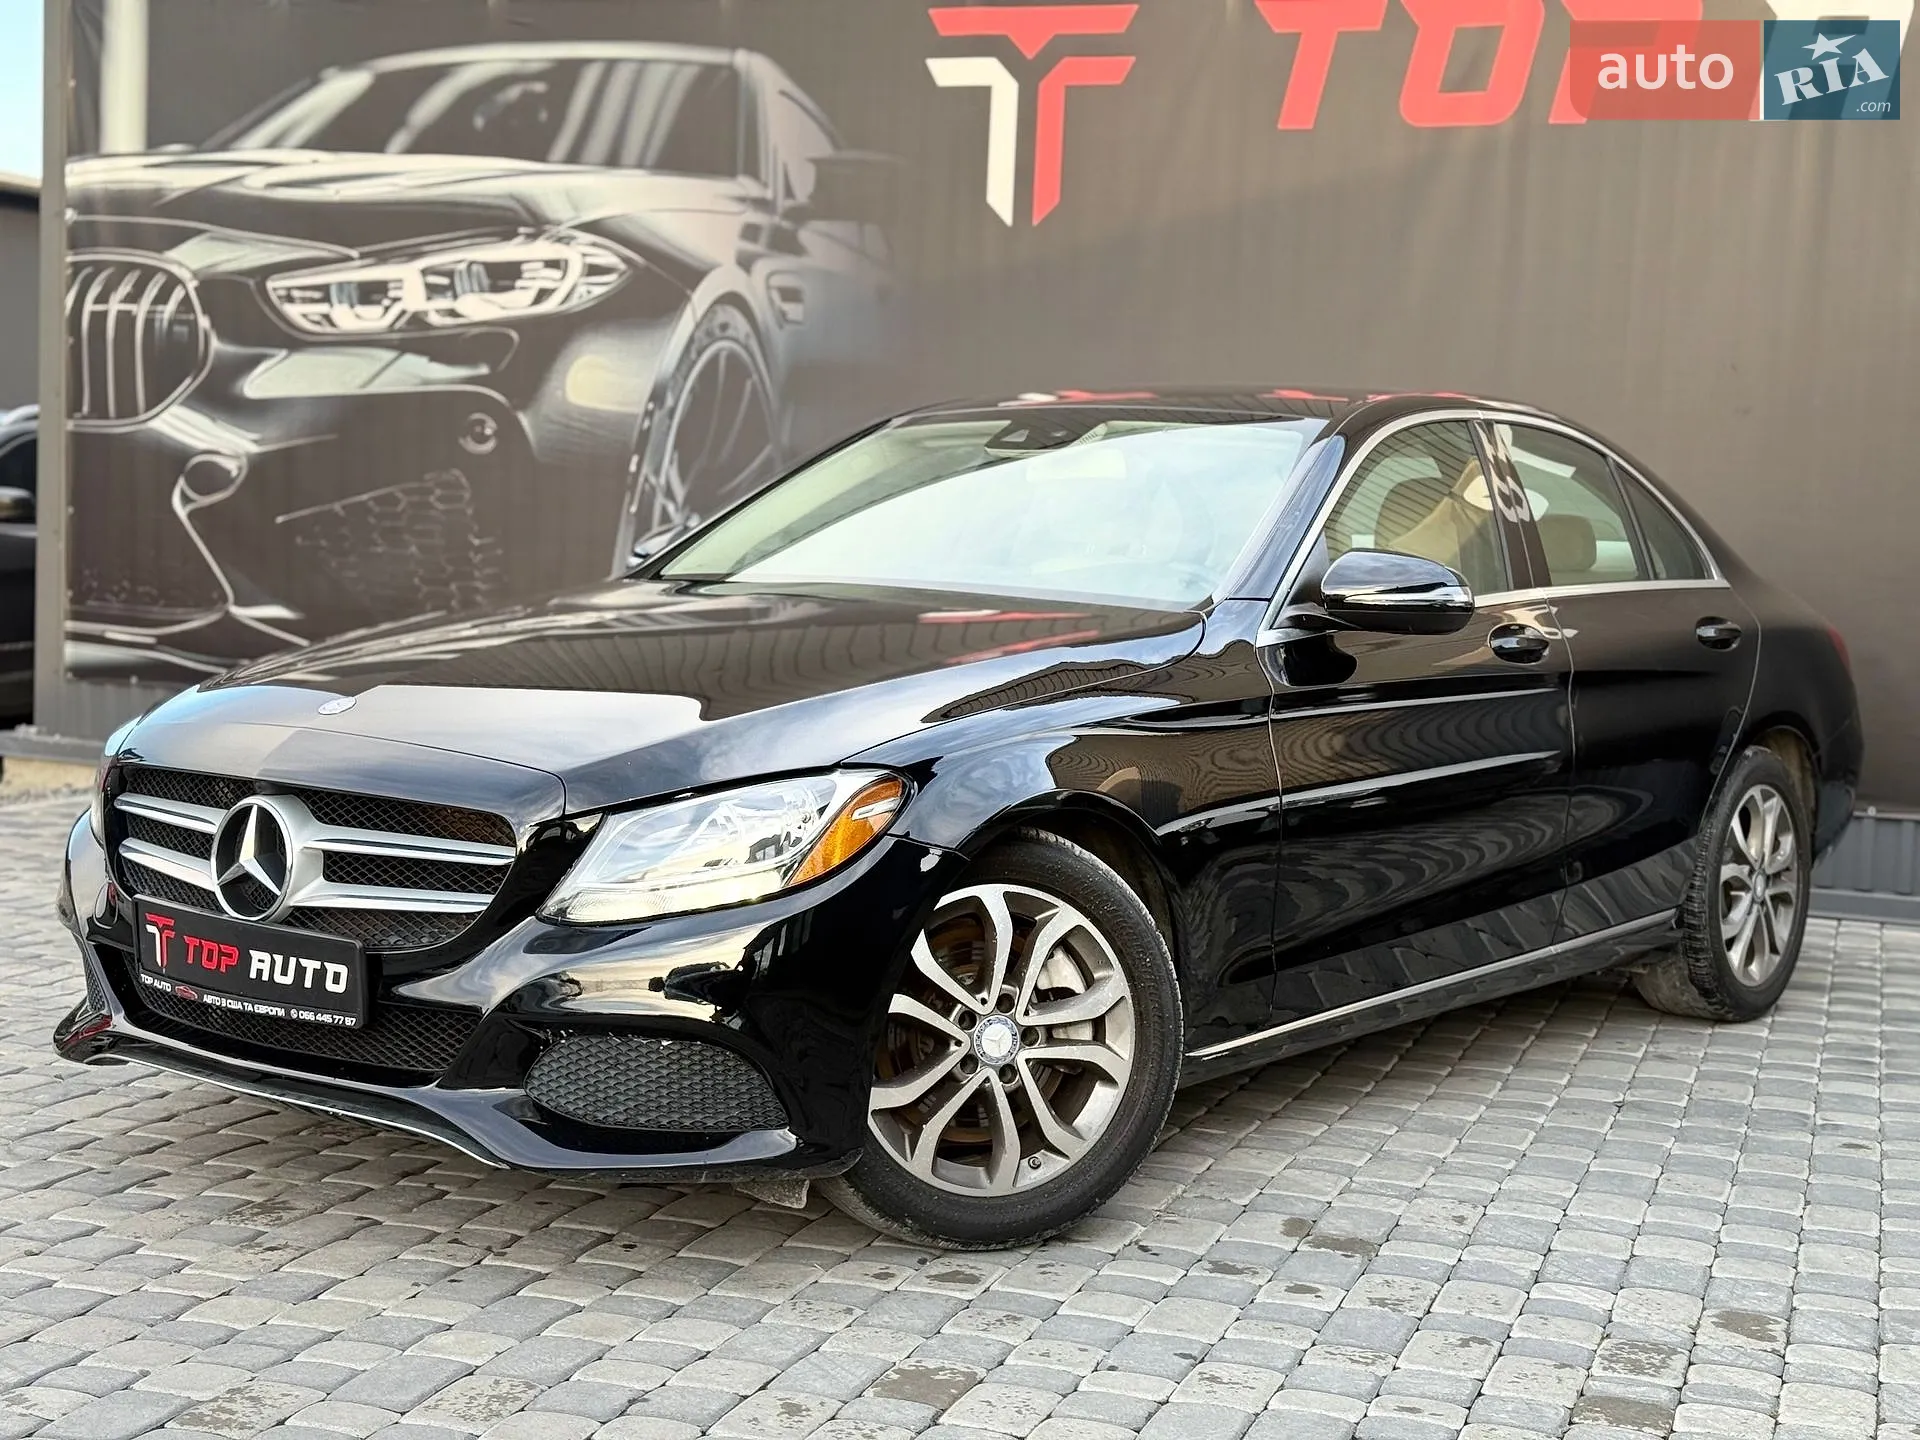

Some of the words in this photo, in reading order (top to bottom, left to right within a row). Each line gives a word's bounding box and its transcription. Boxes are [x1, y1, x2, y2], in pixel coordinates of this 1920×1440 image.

[1256, 0, 1702, 129] TOP
[140, 973, 154, 984] TOP
[153, 979, 172, 992] AUTO
[184, 935, 240, 974] TOP
[249, 949, 348, 994] AUTO
[316, 1013, 333, 1023] 445
[333, 1015, 344, 1024] 77
